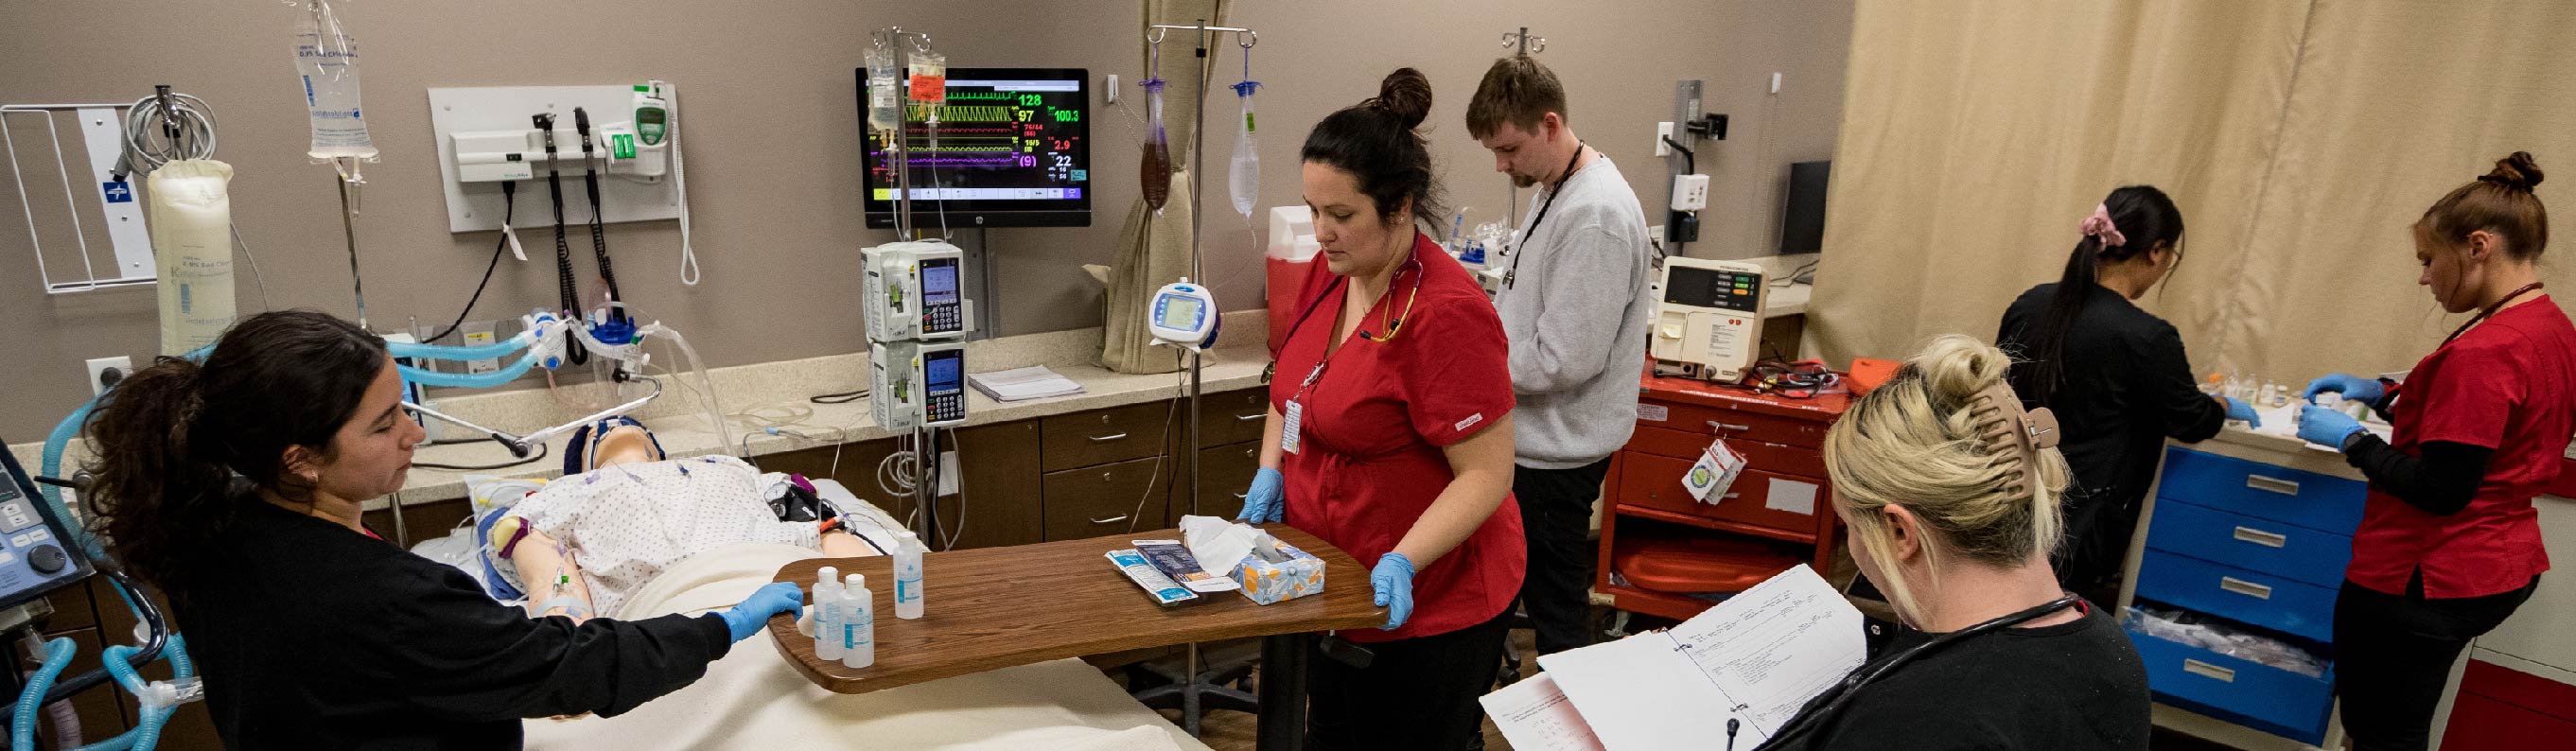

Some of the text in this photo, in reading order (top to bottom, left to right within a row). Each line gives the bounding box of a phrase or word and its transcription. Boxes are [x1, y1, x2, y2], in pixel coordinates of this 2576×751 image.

[1018, 94, 1042, 106] 128
[1018, 110, 1035, 122] 97
[1054, 110, 1079, 122] 100.3
[1054, 139, 1071, 150] 2.9
[1020, 155, 1037, 166] (9)
[1055, 155, 1072, 167] 22
